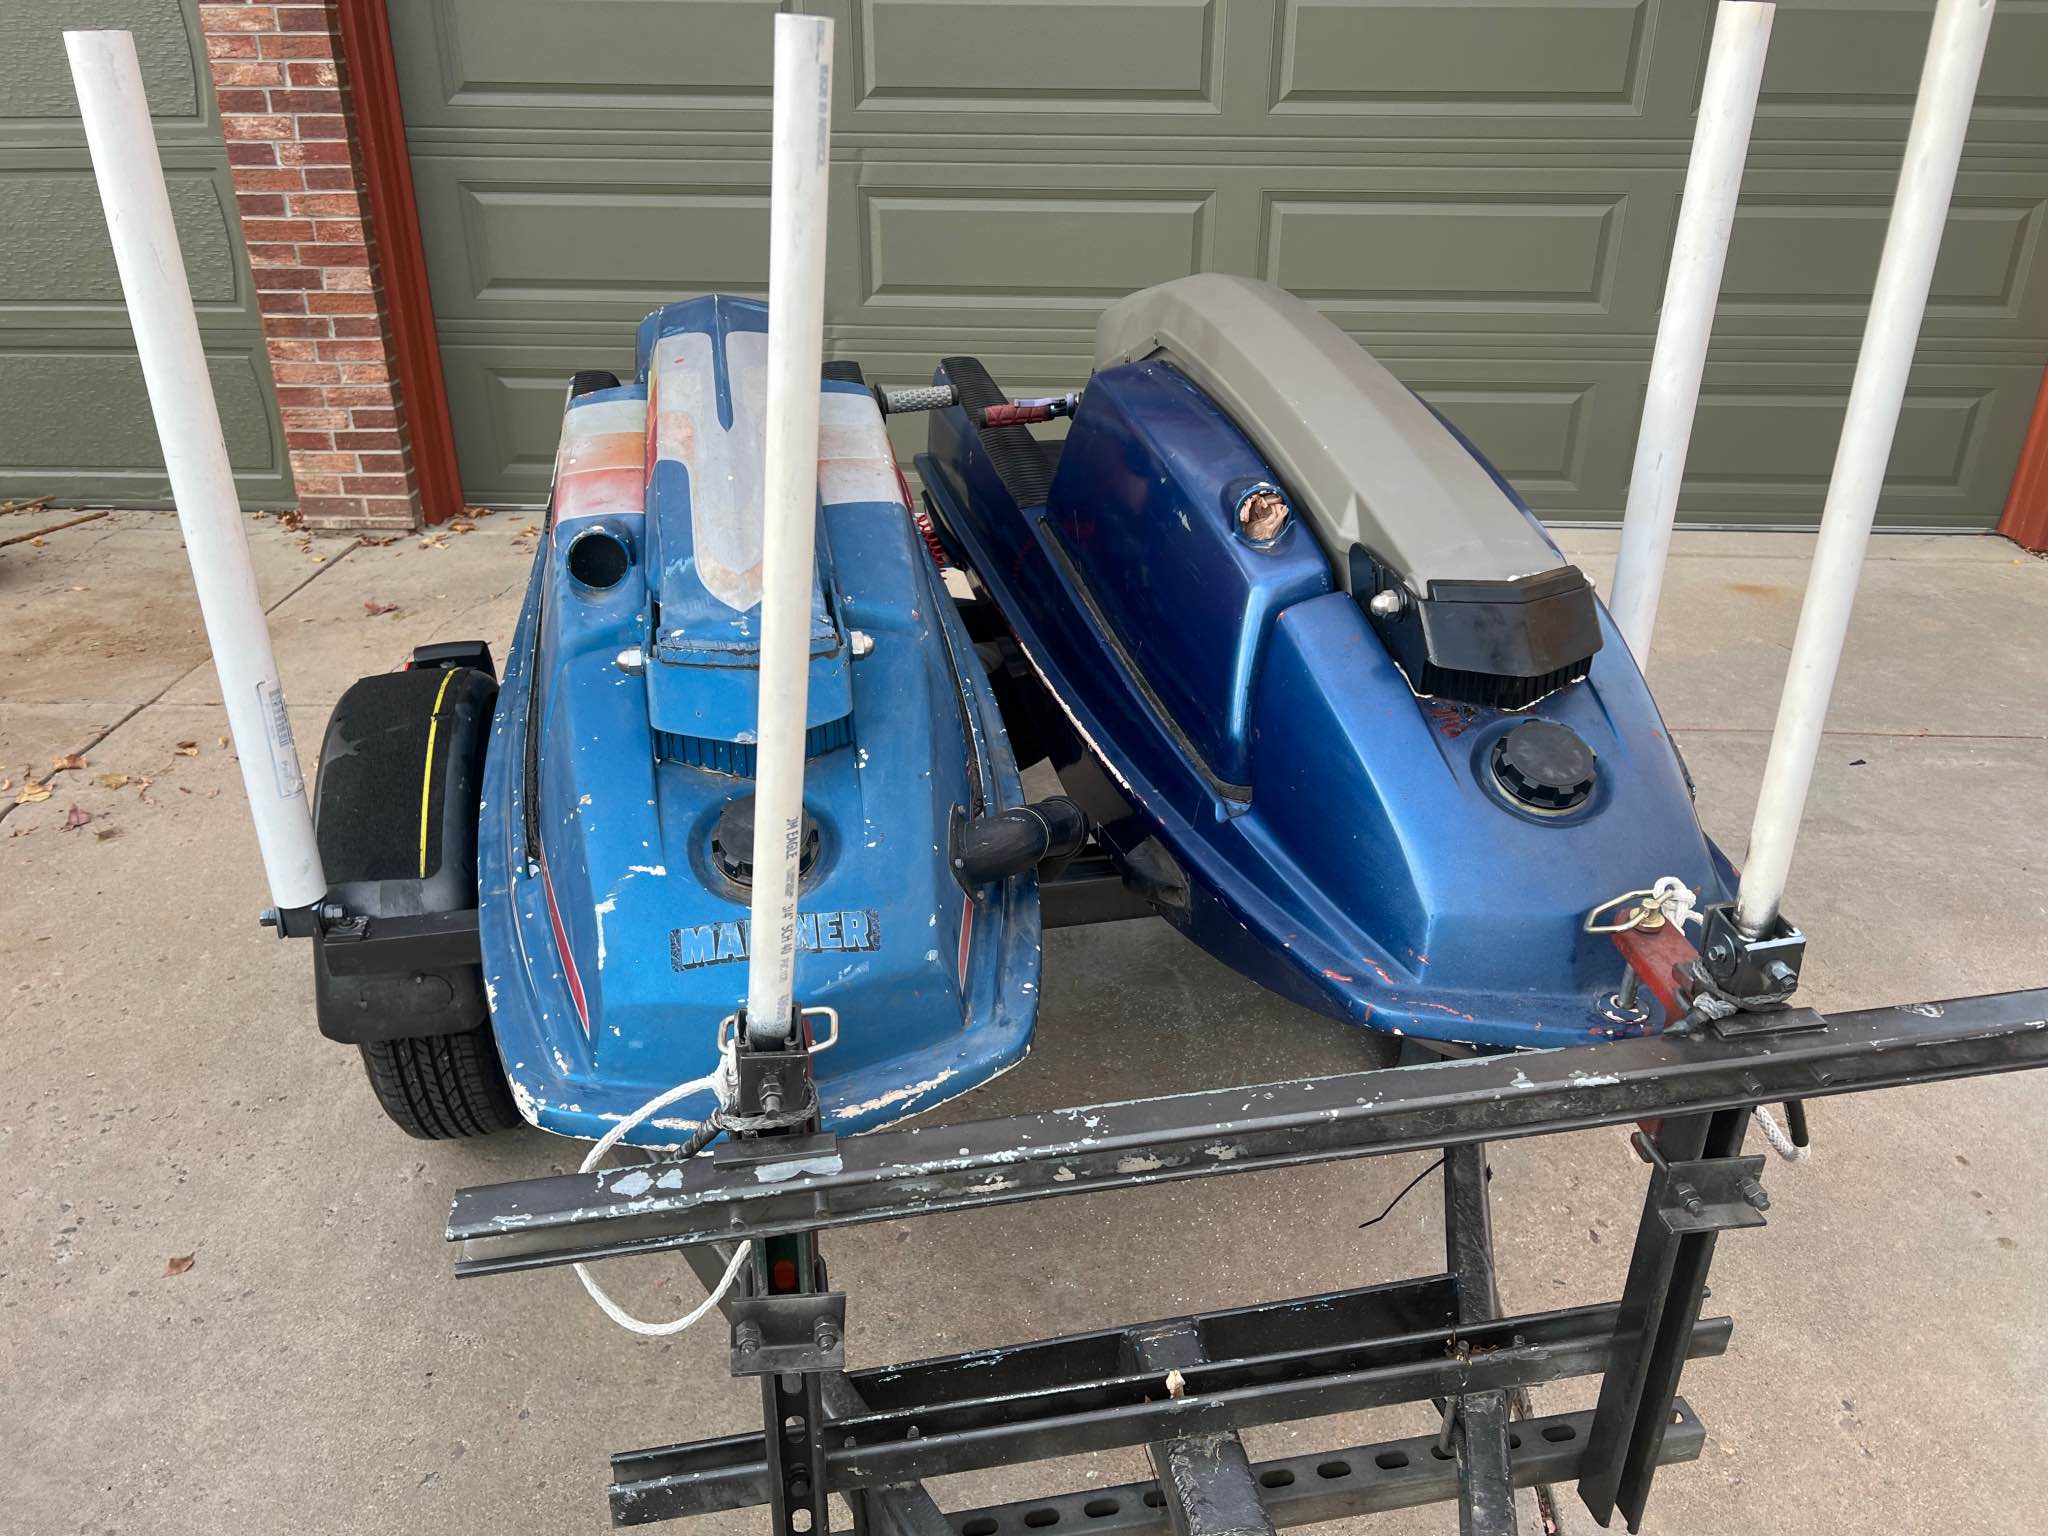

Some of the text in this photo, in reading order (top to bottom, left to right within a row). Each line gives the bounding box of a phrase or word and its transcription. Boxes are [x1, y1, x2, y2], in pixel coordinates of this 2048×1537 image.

[786, 816, 799, 830] JM
[786, 830, 799, 860] EAGLE
[680, 911, 871, 967] MANER
[781, 923, 793, 943] SCH
